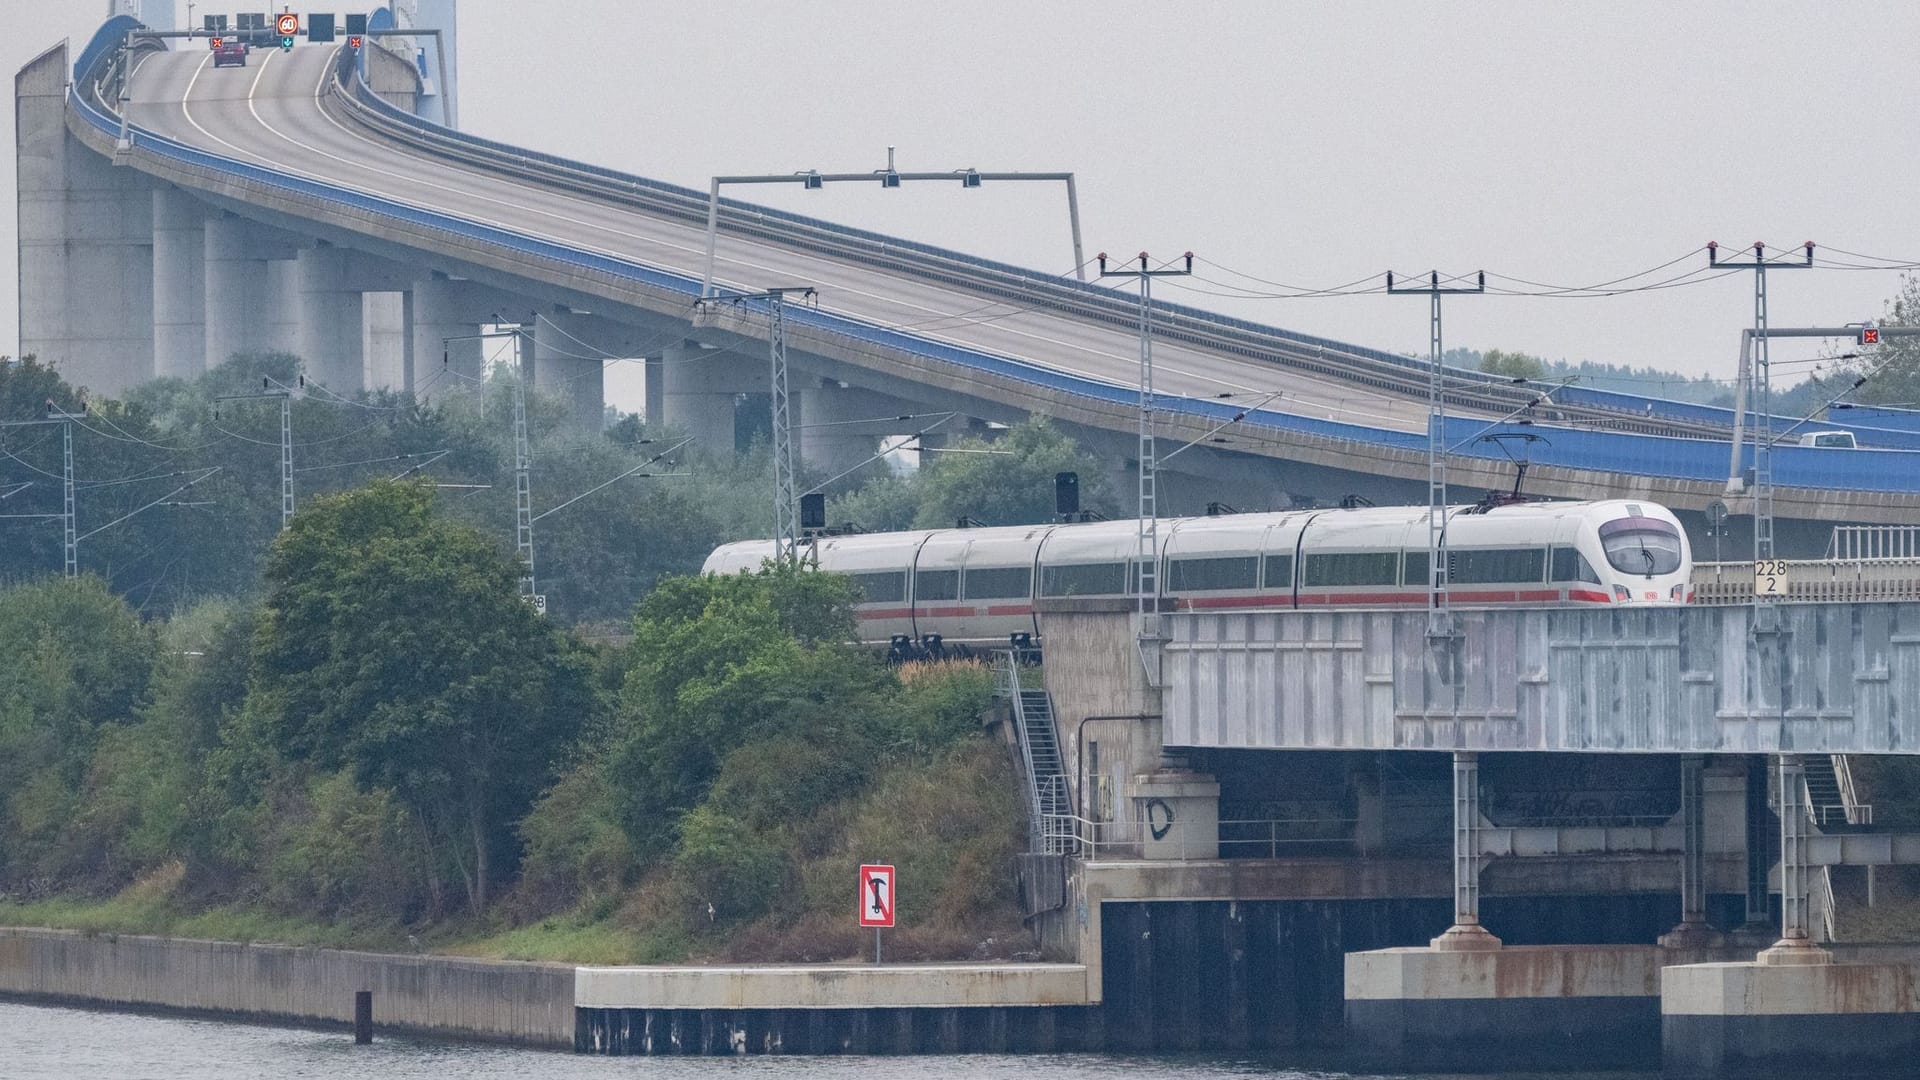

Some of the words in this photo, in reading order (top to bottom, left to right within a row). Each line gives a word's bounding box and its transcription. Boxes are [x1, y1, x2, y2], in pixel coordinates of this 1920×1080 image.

[281, 18, 294, 30] 60
[1756, 561, 1786, 576] 228
[1766, 577, 1777, 592] 2
